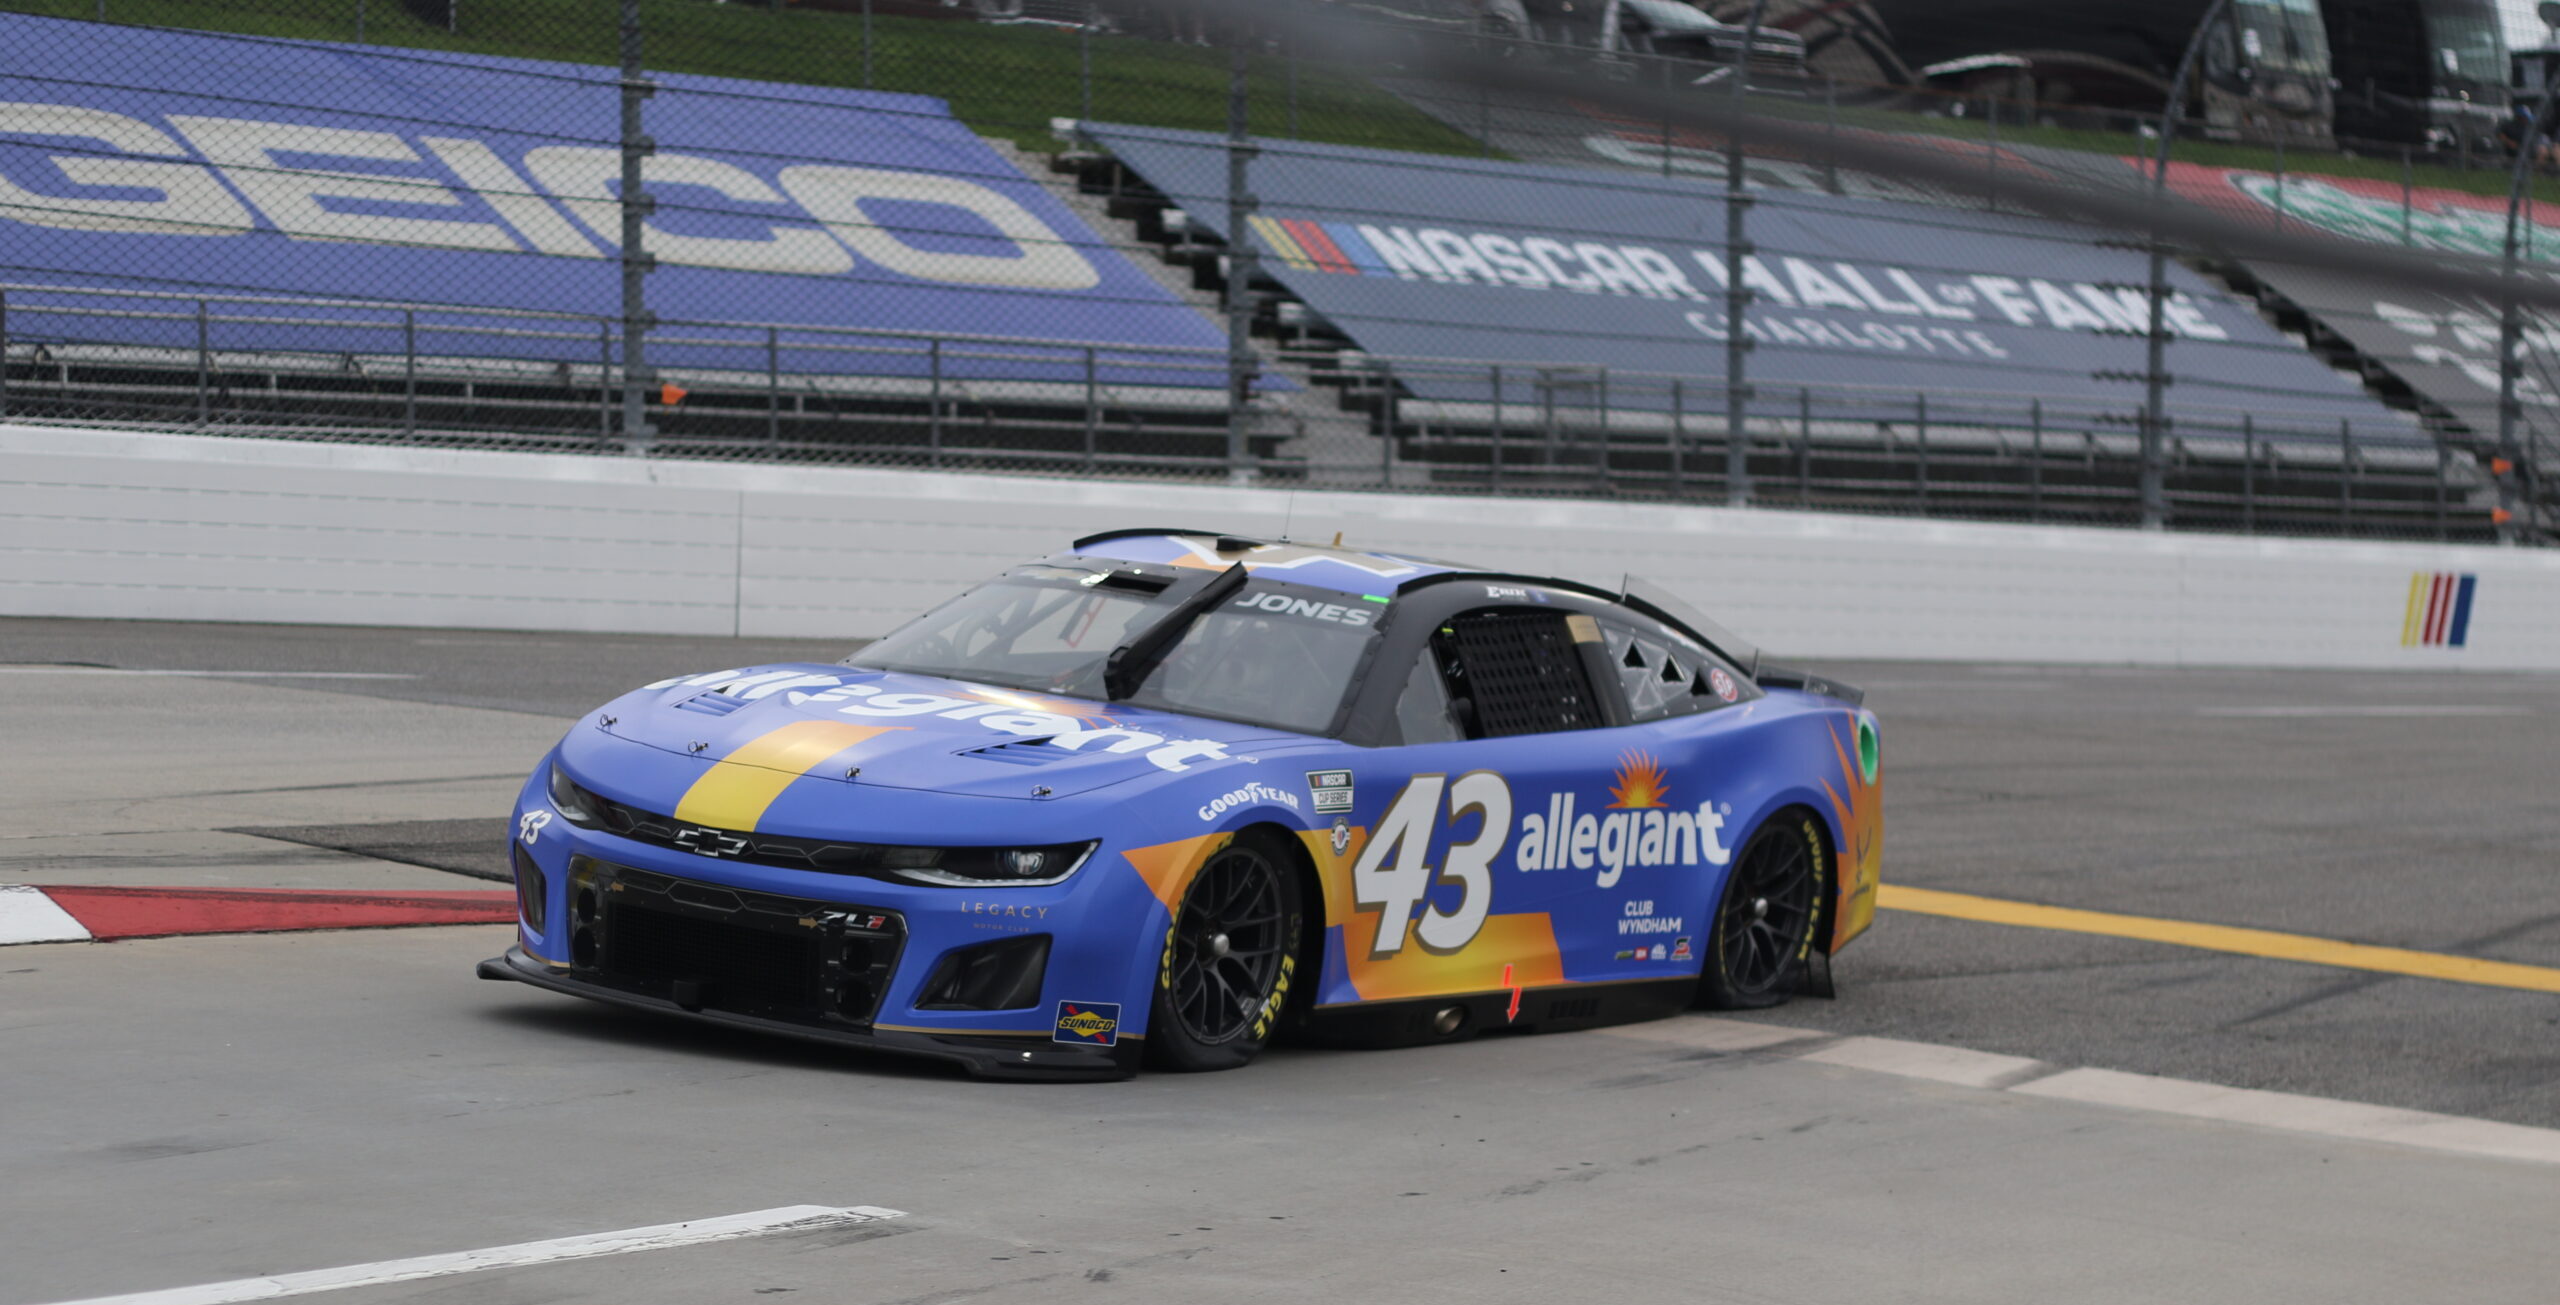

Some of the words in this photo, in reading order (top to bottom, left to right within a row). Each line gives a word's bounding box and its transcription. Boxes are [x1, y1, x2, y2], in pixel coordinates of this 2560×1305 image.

[0, 101, 1101, 289] GEICO
[1359, 224, 1709, 302] NASCAR
[1691, 250, 1975, 321] HALL
[1971, 274, 2229, 341] FAME
[1685, 312, 2008, 358] CHARLOTTE
[1236, 592, 1372, 627] JONES
[1198, 781, 1299, 821] GOODYEAR
[519, 809, 552, 846] 43
[1516, 792, 1731, 888] allegiant
[1353, 770, 1512, 959] 43
[961, 900, 1048, 919] LEGACY
[1618, 917, 1682, 935] WYNDHAM
[1625, 900, 1654, 917] CLUB
[1254, 953, 1294, 1040] EAGLE
[1061, 1016, 1113, 1031] SUNOCO
